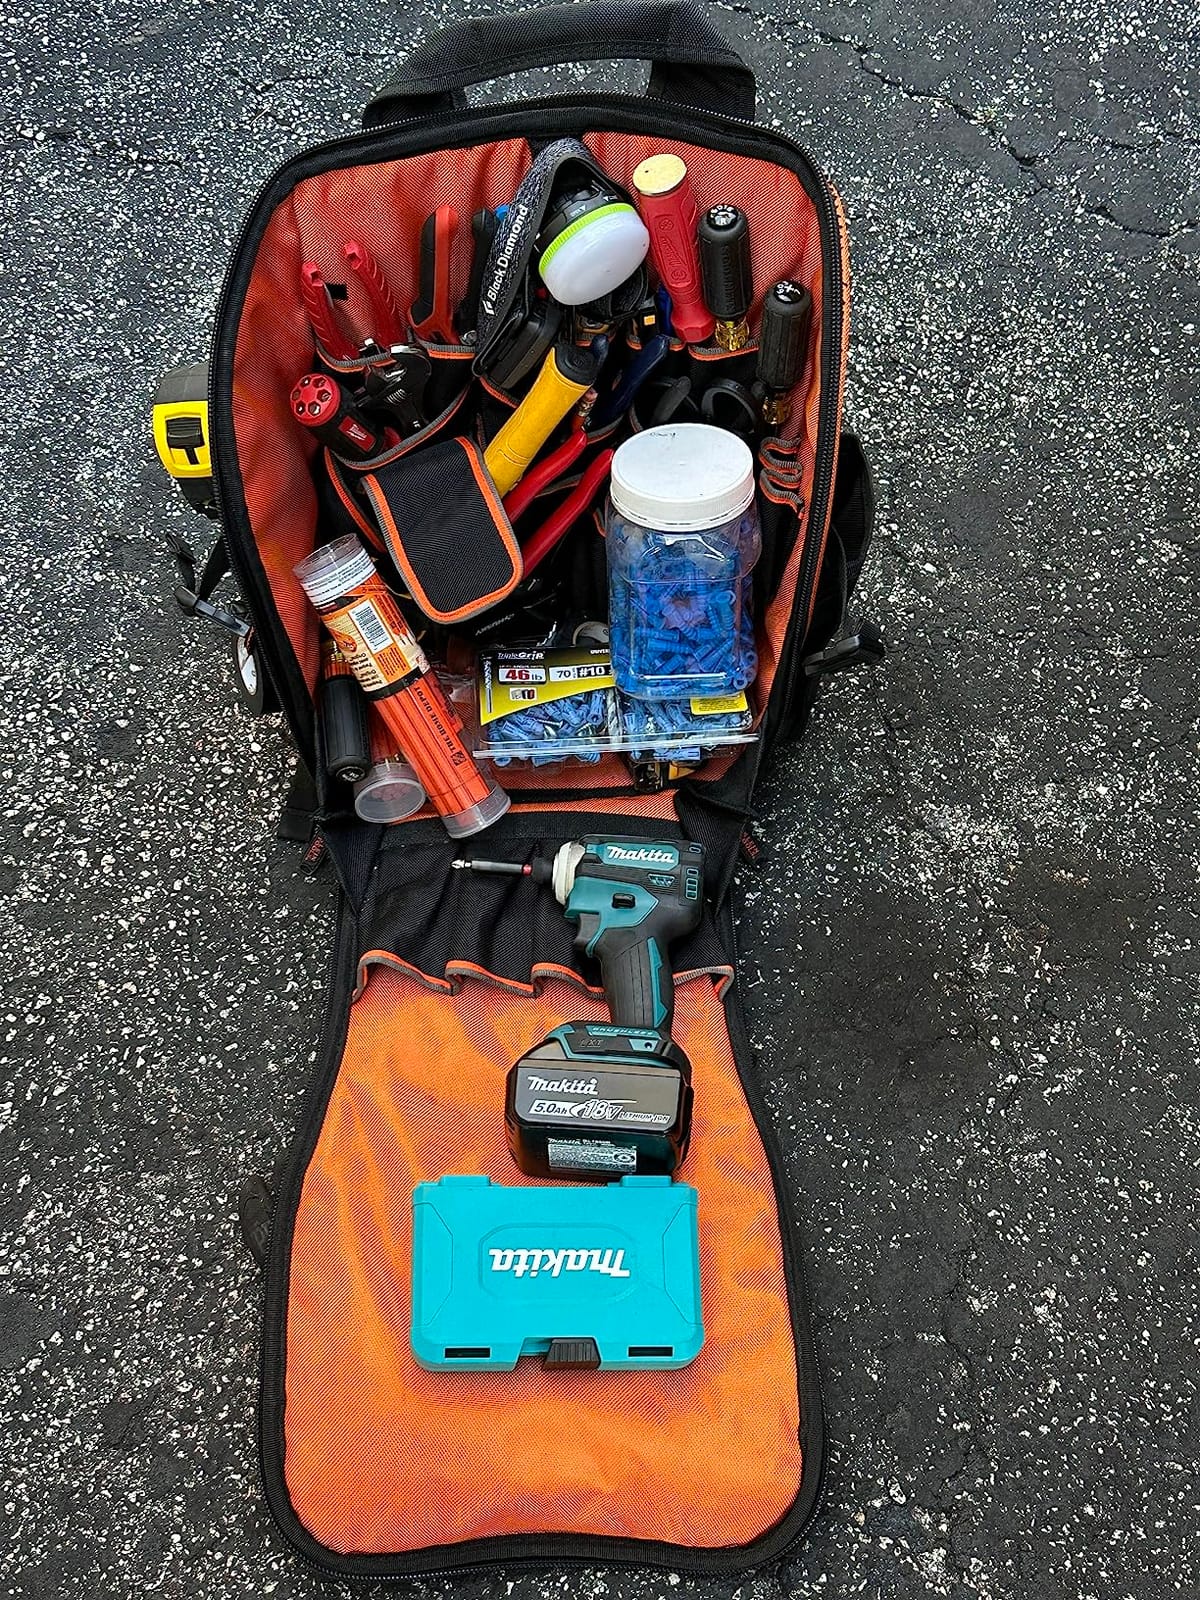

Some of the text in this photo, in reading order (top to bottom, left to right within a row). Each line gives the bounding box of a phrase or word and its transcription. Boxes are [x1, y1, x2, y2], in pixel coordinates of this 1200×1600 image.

[486, 203, 529, 302] Black Diamond
[505, 669, 543, 681] 46 lb
[556, 669, 571, 679] 70
[579, 666, 606, 677] #10
[534, 1101, 568, 1116] 5.0Ah
